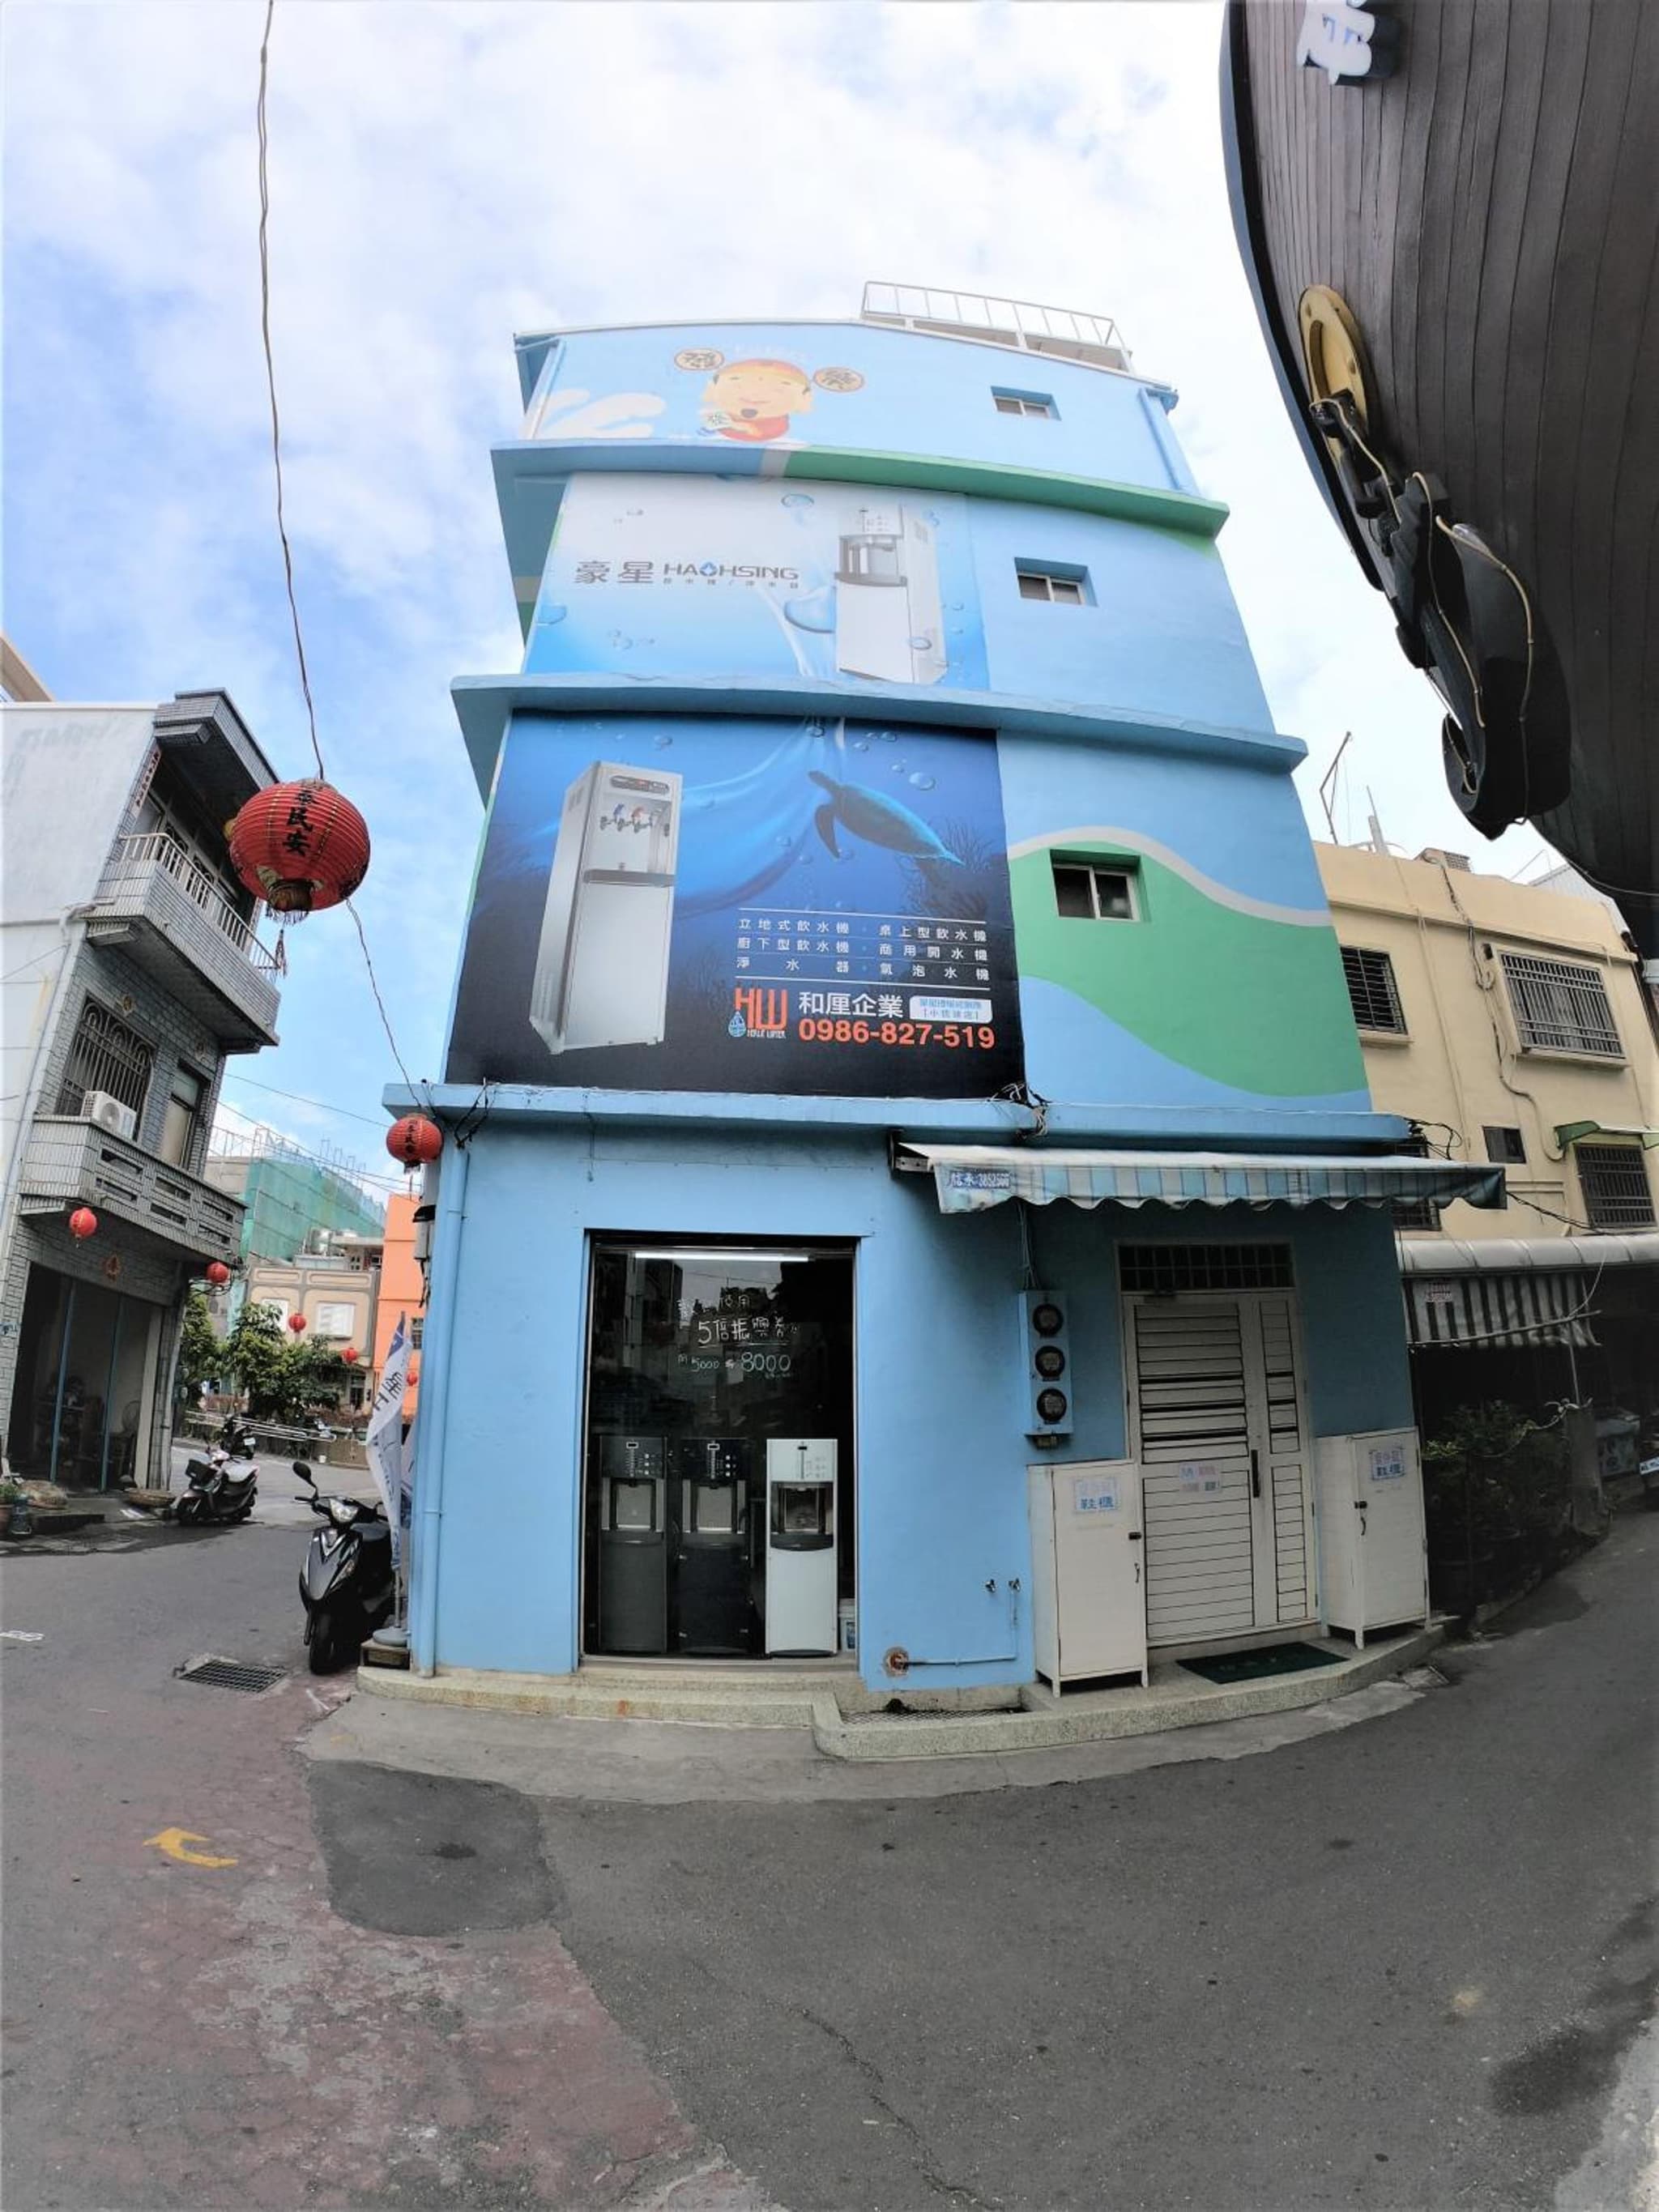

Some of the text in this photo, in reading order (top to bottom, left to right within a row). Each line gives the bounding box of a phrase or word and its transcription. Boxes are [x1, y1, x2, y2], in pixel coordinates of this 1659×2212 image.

[575, 560, 799, 584] 豪星 HAOHSING
[739, 918, 987, 942] 立地式飲水機 桌上型飲水機
[737, 936, 849, 953] 廚下型飲水機
[736, 956, 849, 973] 淨水器
[799, 991, 904, 1018] 和厘企業
[799, 1018, 995, 1048] 0986-827-519
[740, 1352, 791, 1372] 8000
